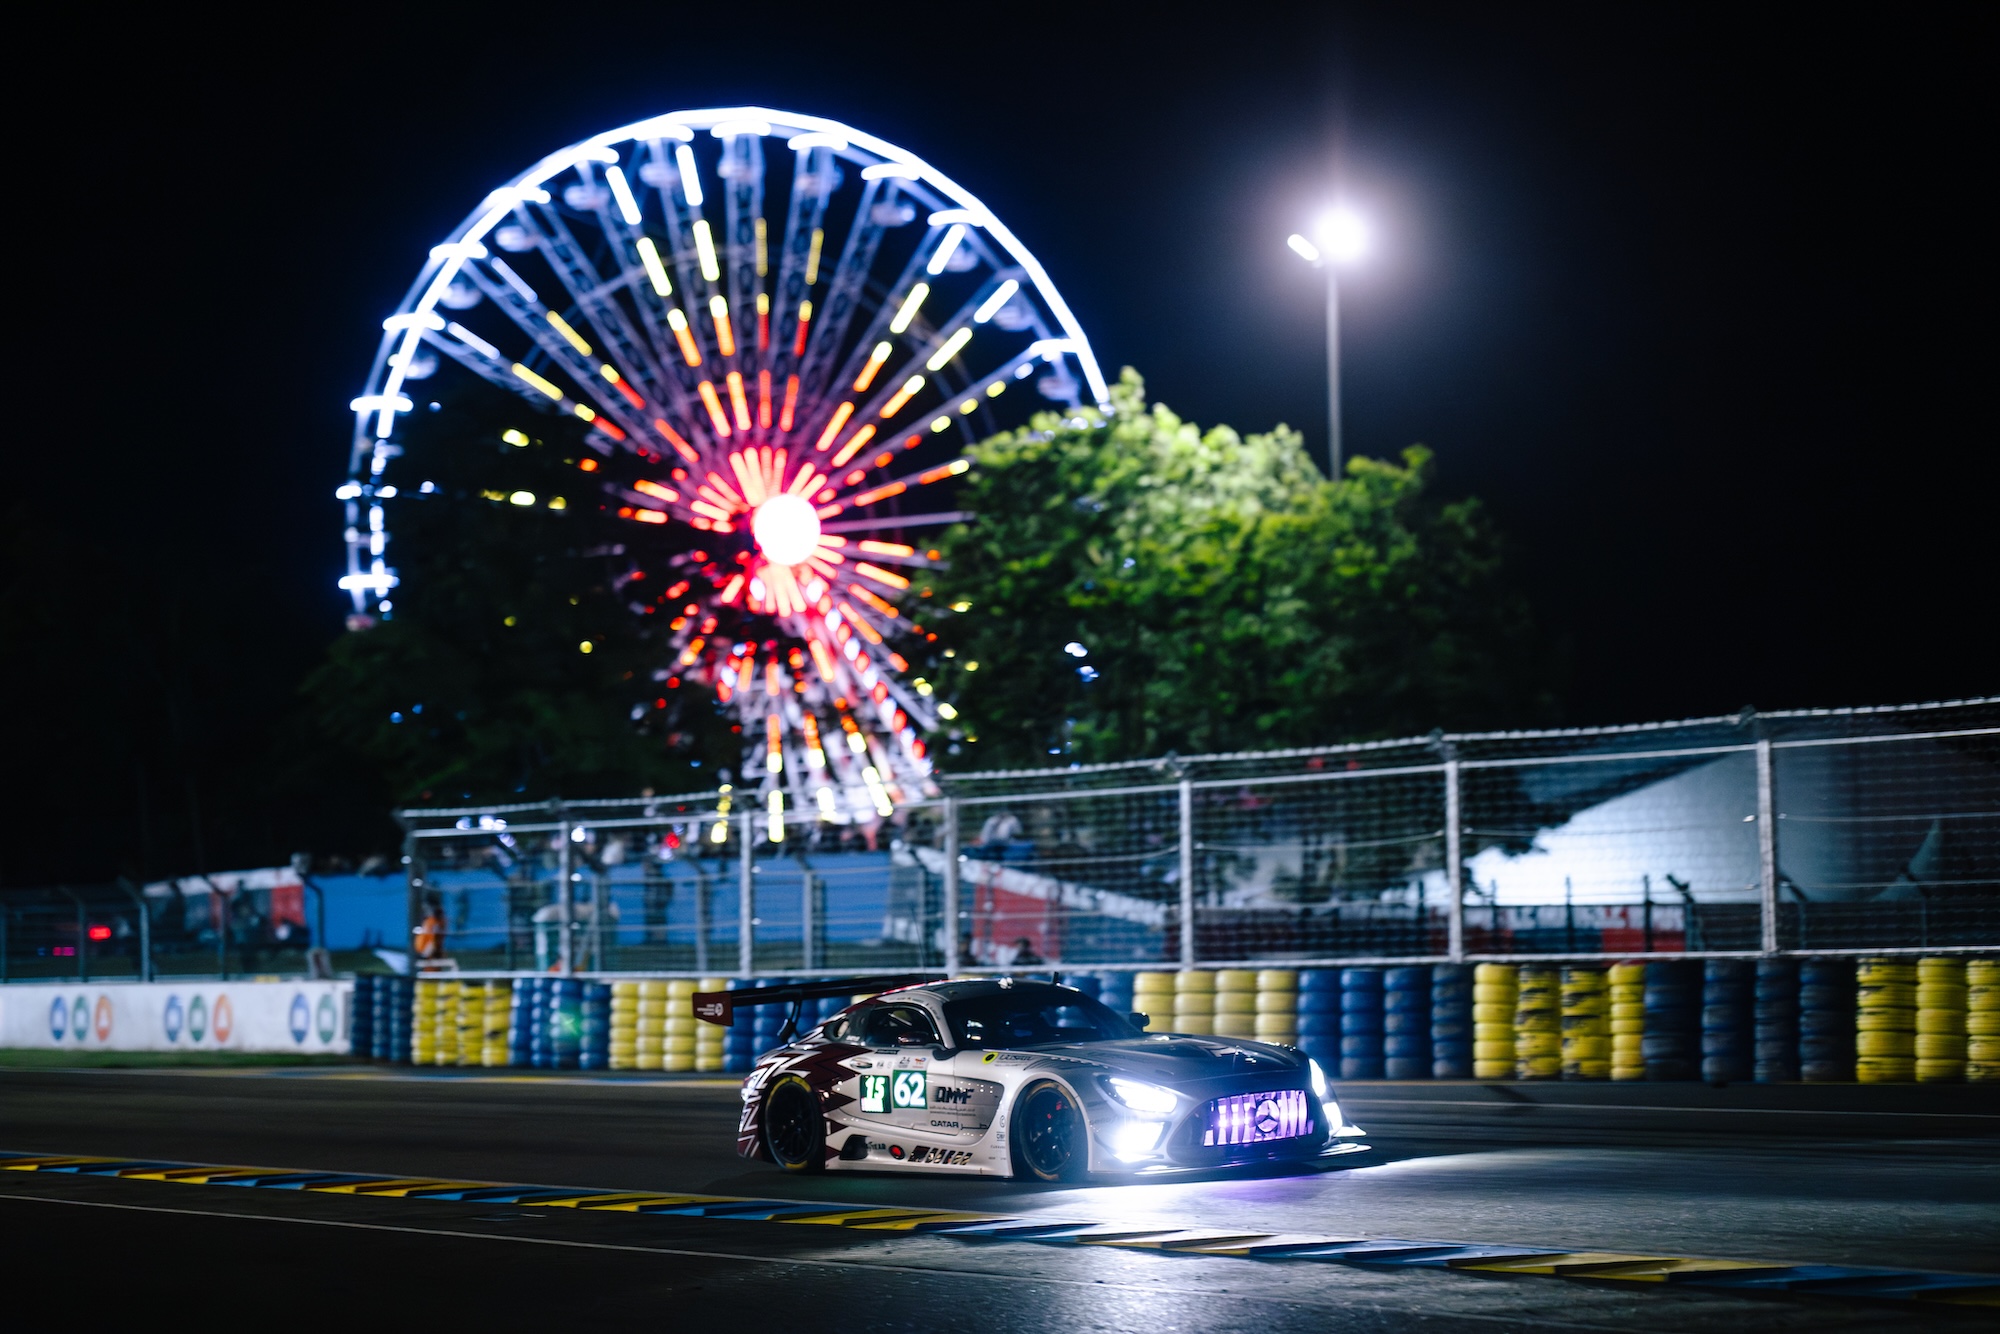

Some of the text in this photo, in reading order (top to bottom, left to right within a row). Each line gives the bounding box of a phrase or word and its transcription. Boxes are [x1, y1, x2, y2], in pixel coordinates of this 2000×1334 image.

[864, 1075, 885, 1099] 15
[894, 1072, 926, 1107] 62
[930, 1120, 960, 1129] QATAR
